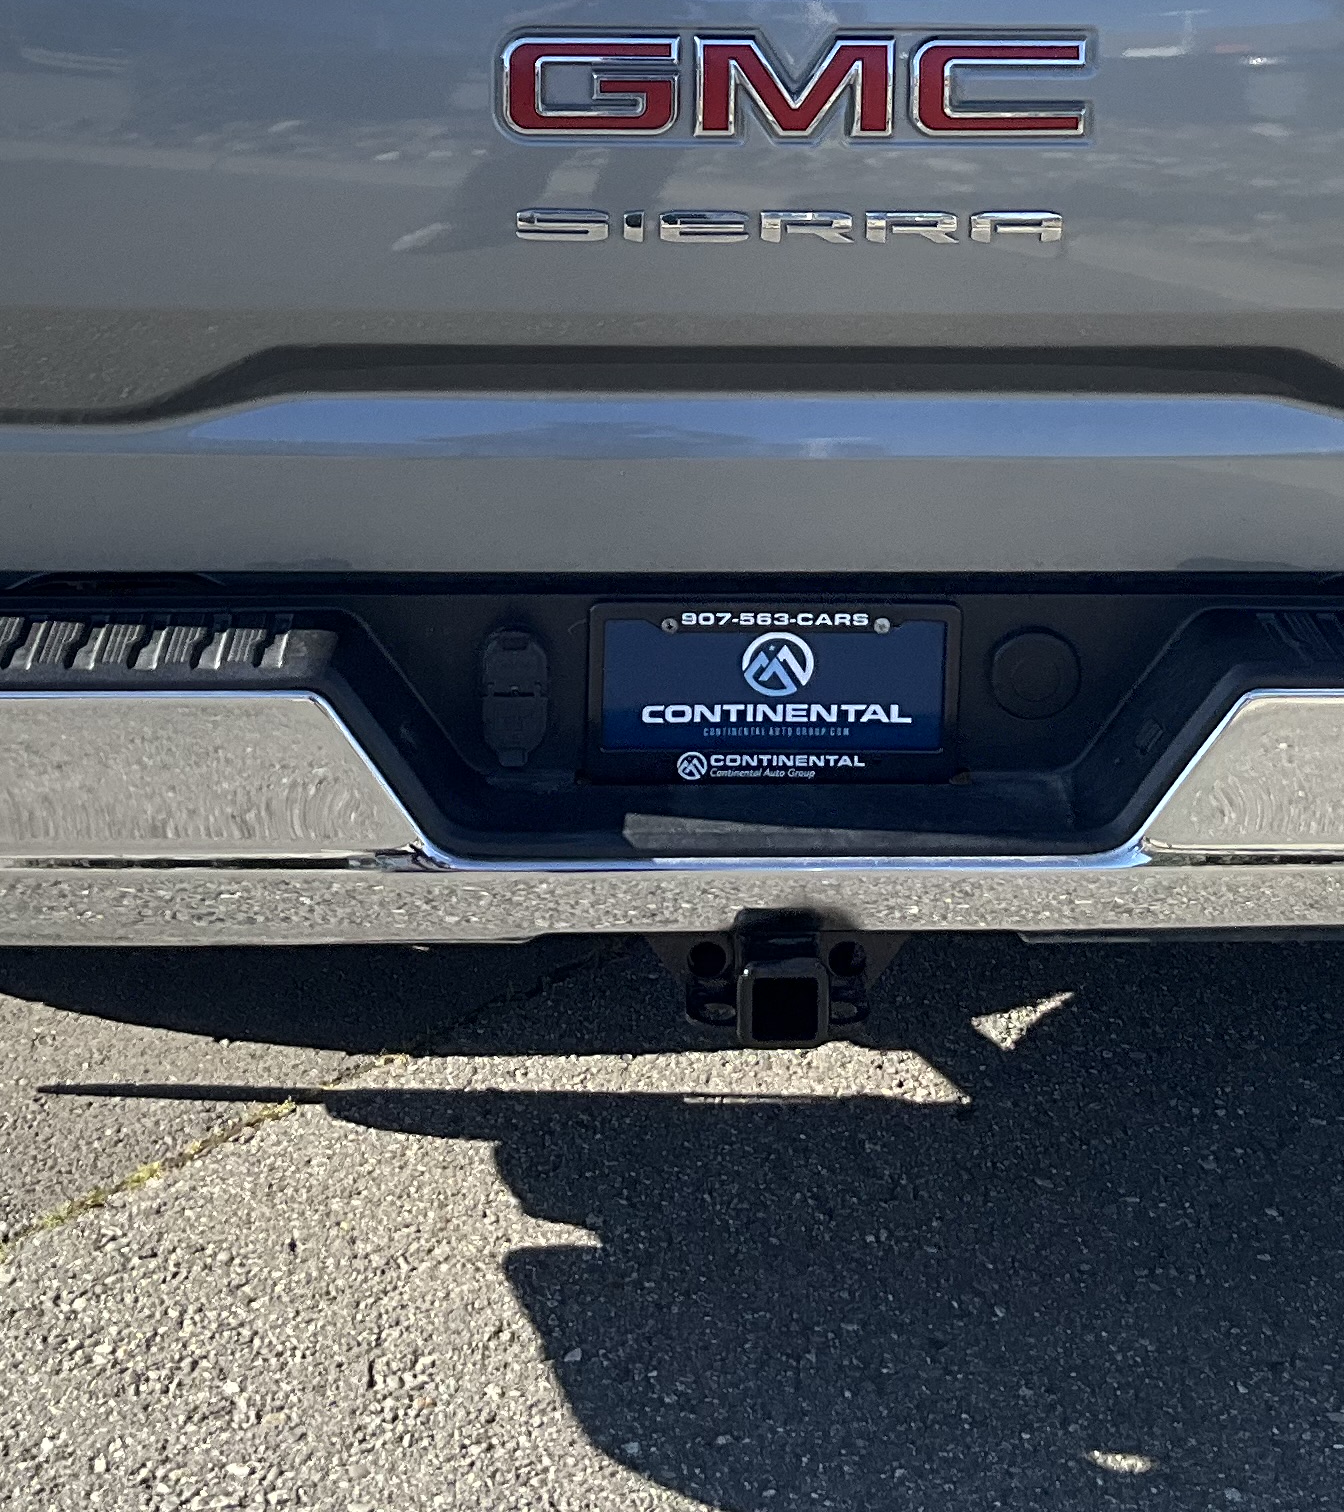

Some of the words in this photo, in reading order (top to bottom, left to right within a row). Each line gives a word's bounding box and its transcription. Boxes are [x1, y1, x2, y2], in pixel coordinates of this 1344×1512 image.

[500, 34, 1088, 140] GMC
[514, 208, 1064, 245] SIERRA
[680, 612, 870, 626] 907-563-CARS
[641, 703, 913, 725] CONTINENTAL
[709, 754, 867, 768] CONTINENTAL
[709, 768, 763, 778] Continental
[764, 768, 786, 778] Auto
[788, 768, 817, 779] Group
